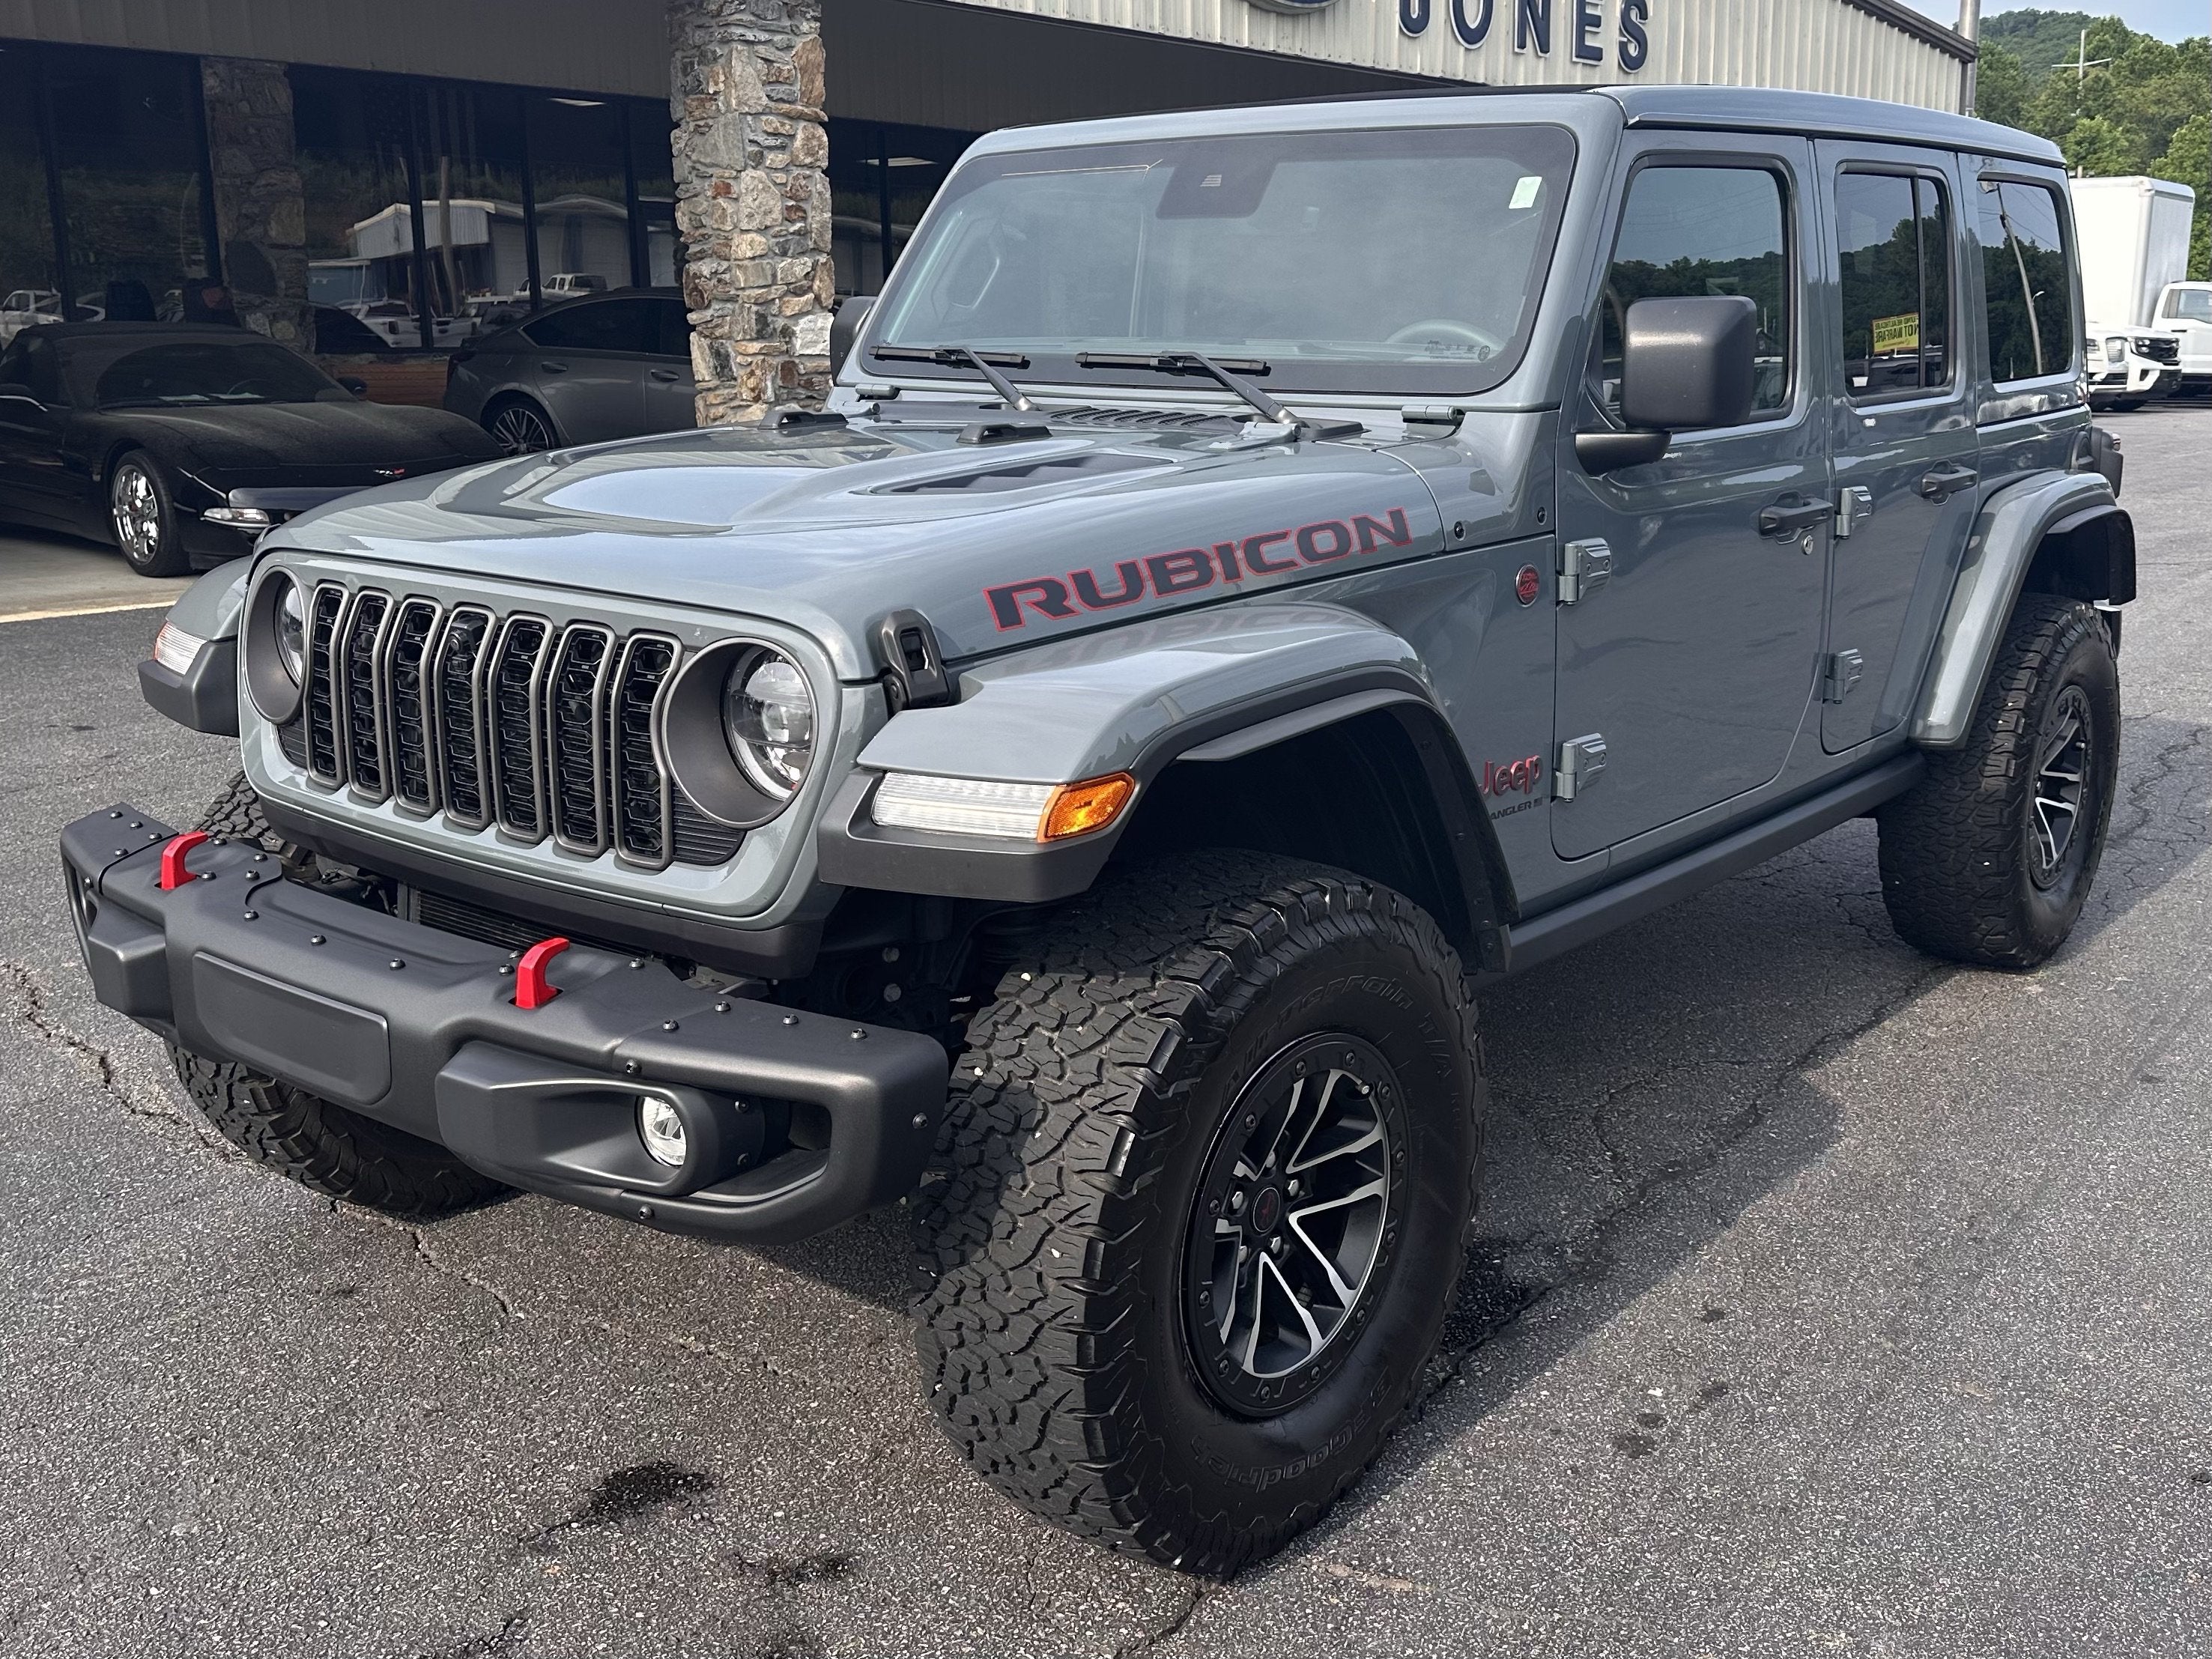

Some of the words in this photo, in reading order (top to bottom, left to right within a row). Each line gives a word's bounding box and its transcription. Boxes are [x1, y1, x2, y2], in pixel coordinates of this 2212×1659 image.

[983, 508, 1413, 631] RUBICON
[1478, 755, 1542, 796] Jeep
[1491, 801, 1533, 819] ANGLER
